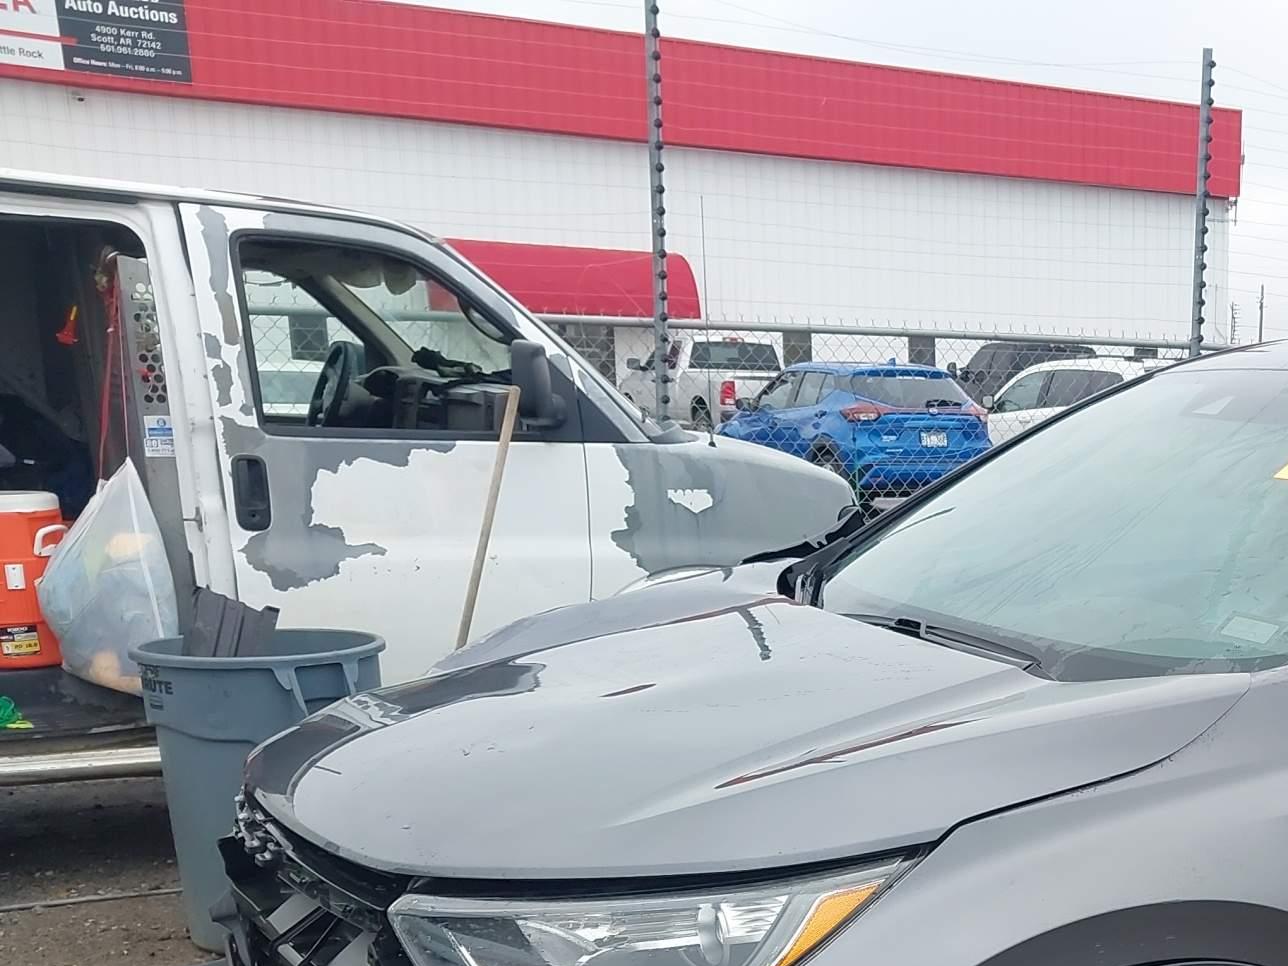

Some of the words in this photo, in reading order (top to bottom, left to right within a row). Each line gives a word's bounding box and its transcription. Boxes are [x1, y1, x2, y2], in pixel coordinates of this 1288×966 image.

[65, 0, 103, 14] Auto
[107, 1, 178, 24] Auctions
[95, 25, 117, 35] 4900
[120, 29, 139, 38] Kerr
[90, 33, 117, 45] Scott,
[120, 38, 132, 46] AR
[137, 40, 162, 49] 72142
[0, 45, 16, 56] ttle
[18, 47, 45, 60] Rock
